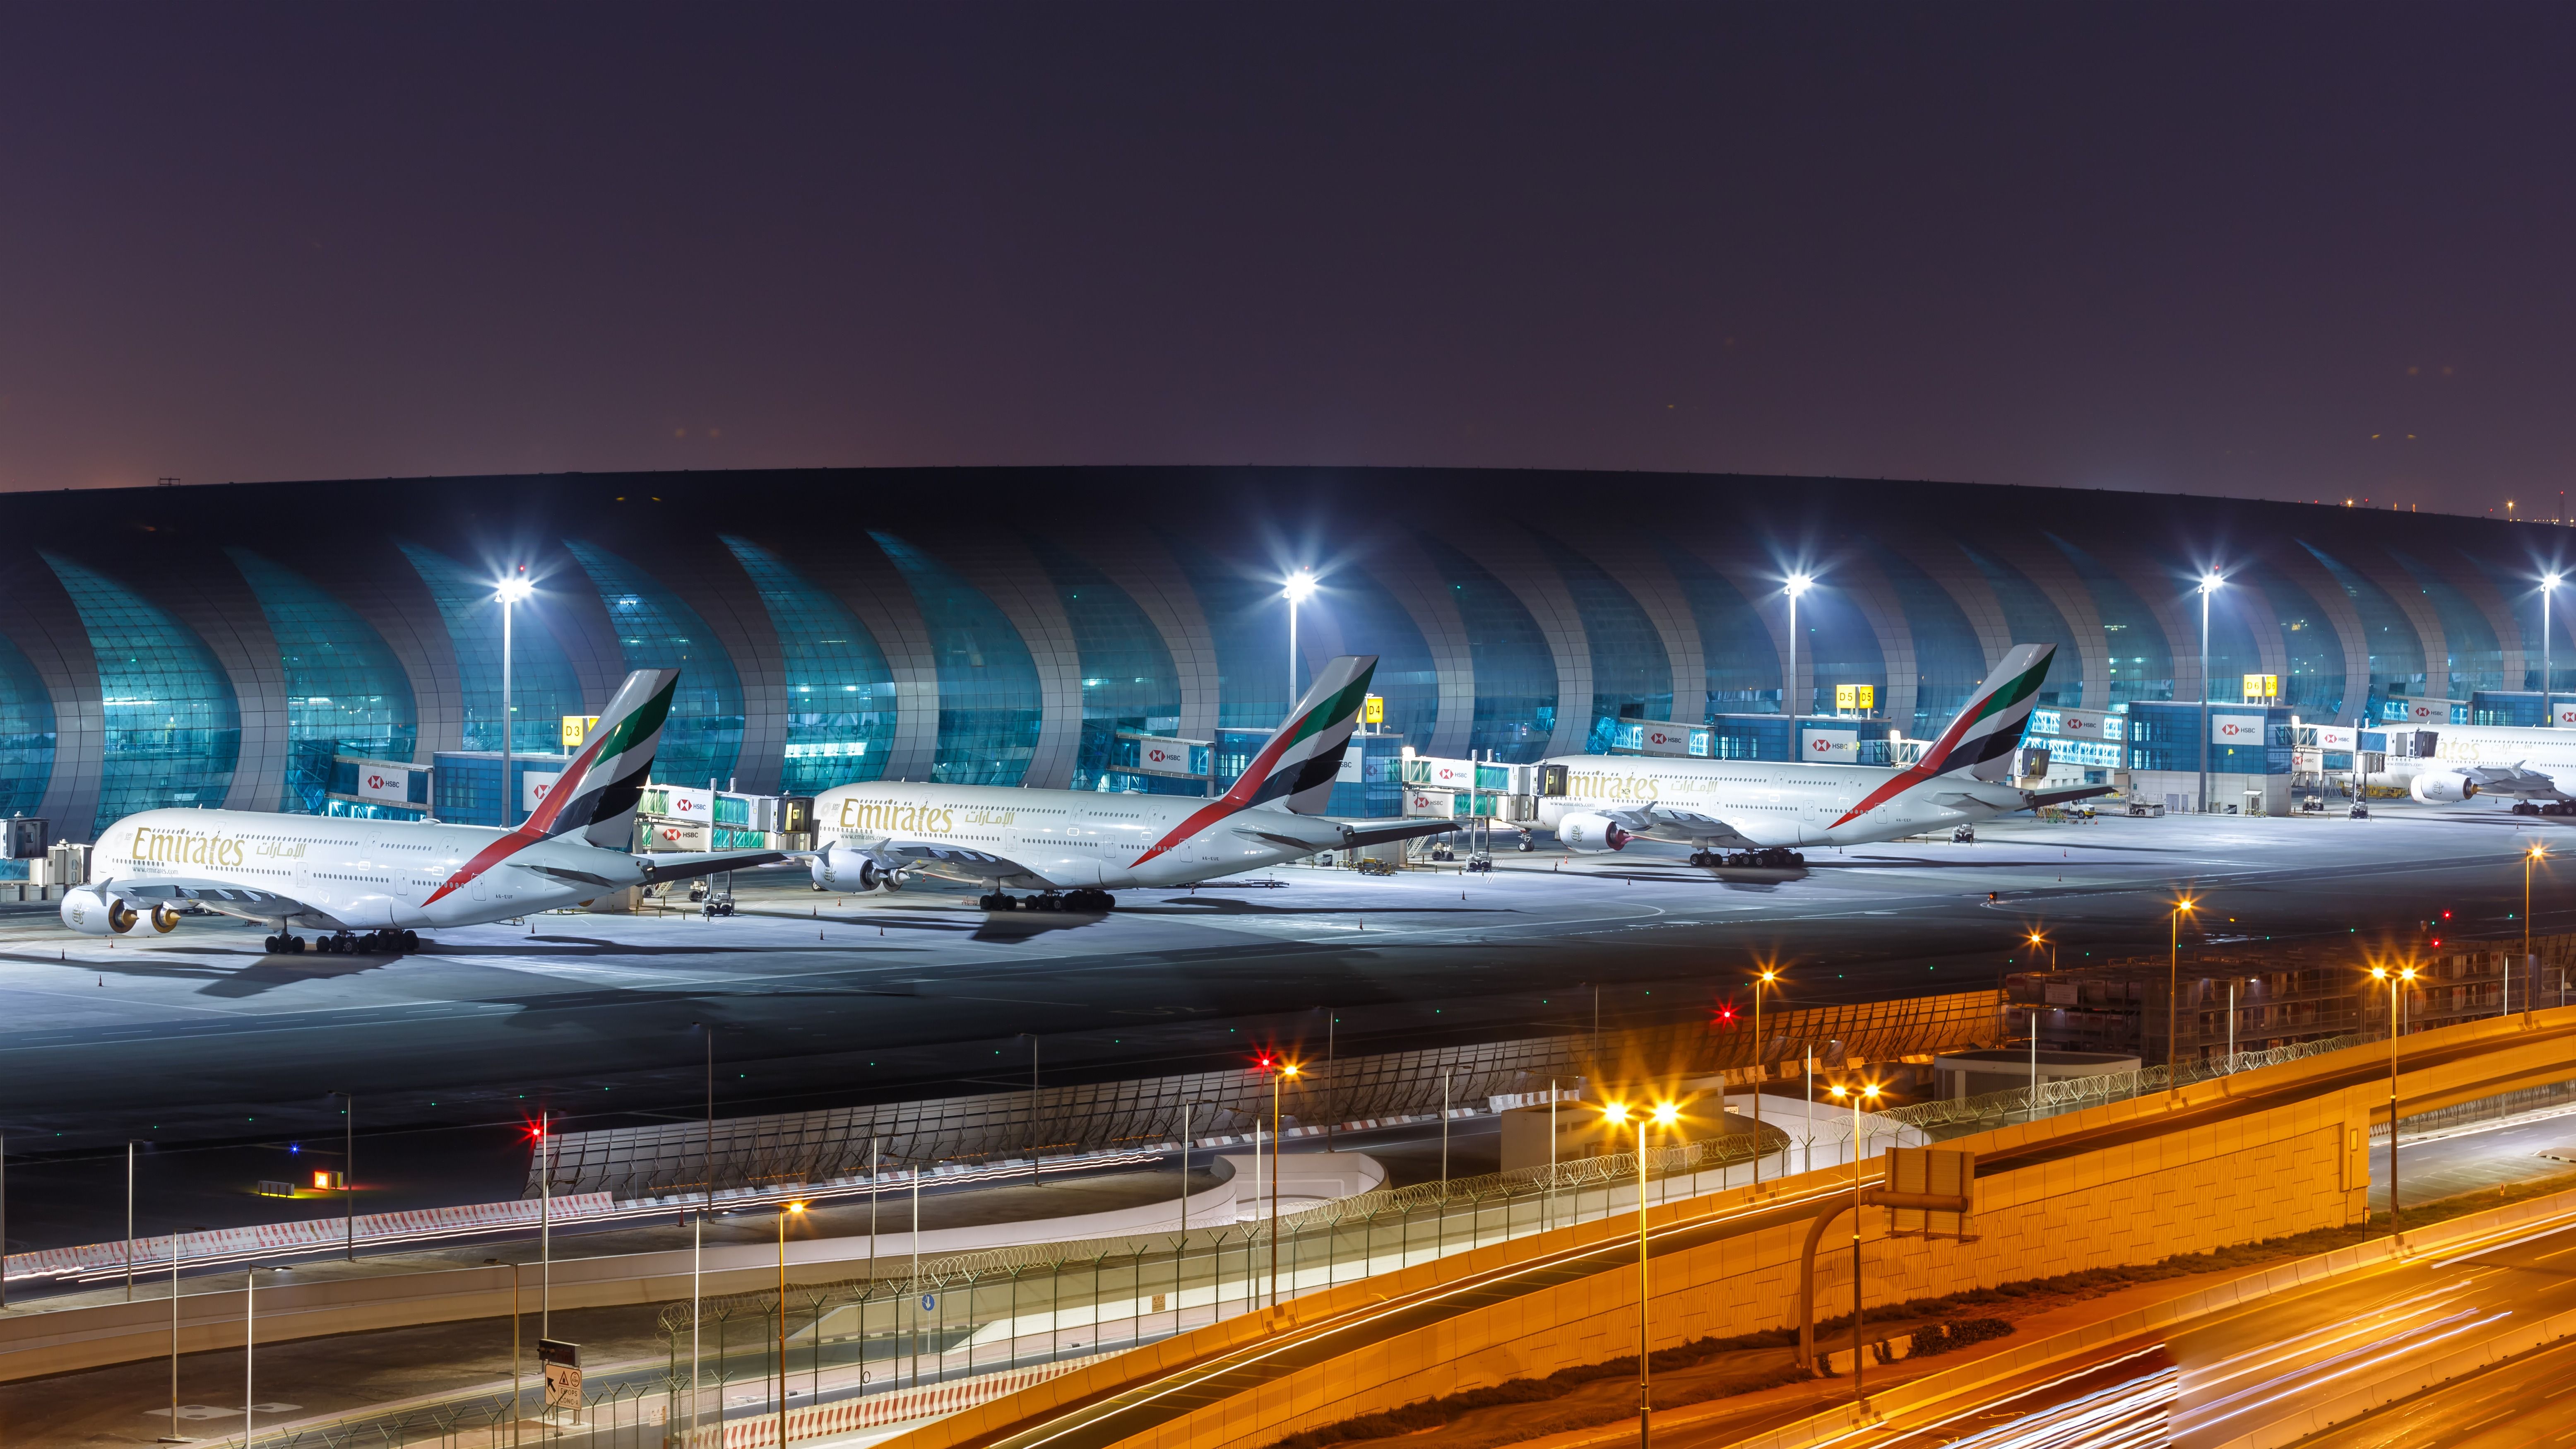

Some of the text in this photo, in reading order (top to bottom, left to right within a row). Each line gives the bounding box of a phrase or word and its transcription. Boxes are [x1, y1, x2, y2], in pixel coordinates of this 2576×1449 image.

[1840, 693, 1852, 701] D 5
[1867, 693, 1871, 701] 5
[1369, 705, 1380, 715] D 4
[566, 726, 579, 736] D 3
[2436, 740, 2480, 761] ates
[1566, 770, 1660, 800] mirates
[840, 798, 953, 833] Emirates
[132, 827, 245, 867] Emirates
[132, 867, 178, 875] www.emirates.com
